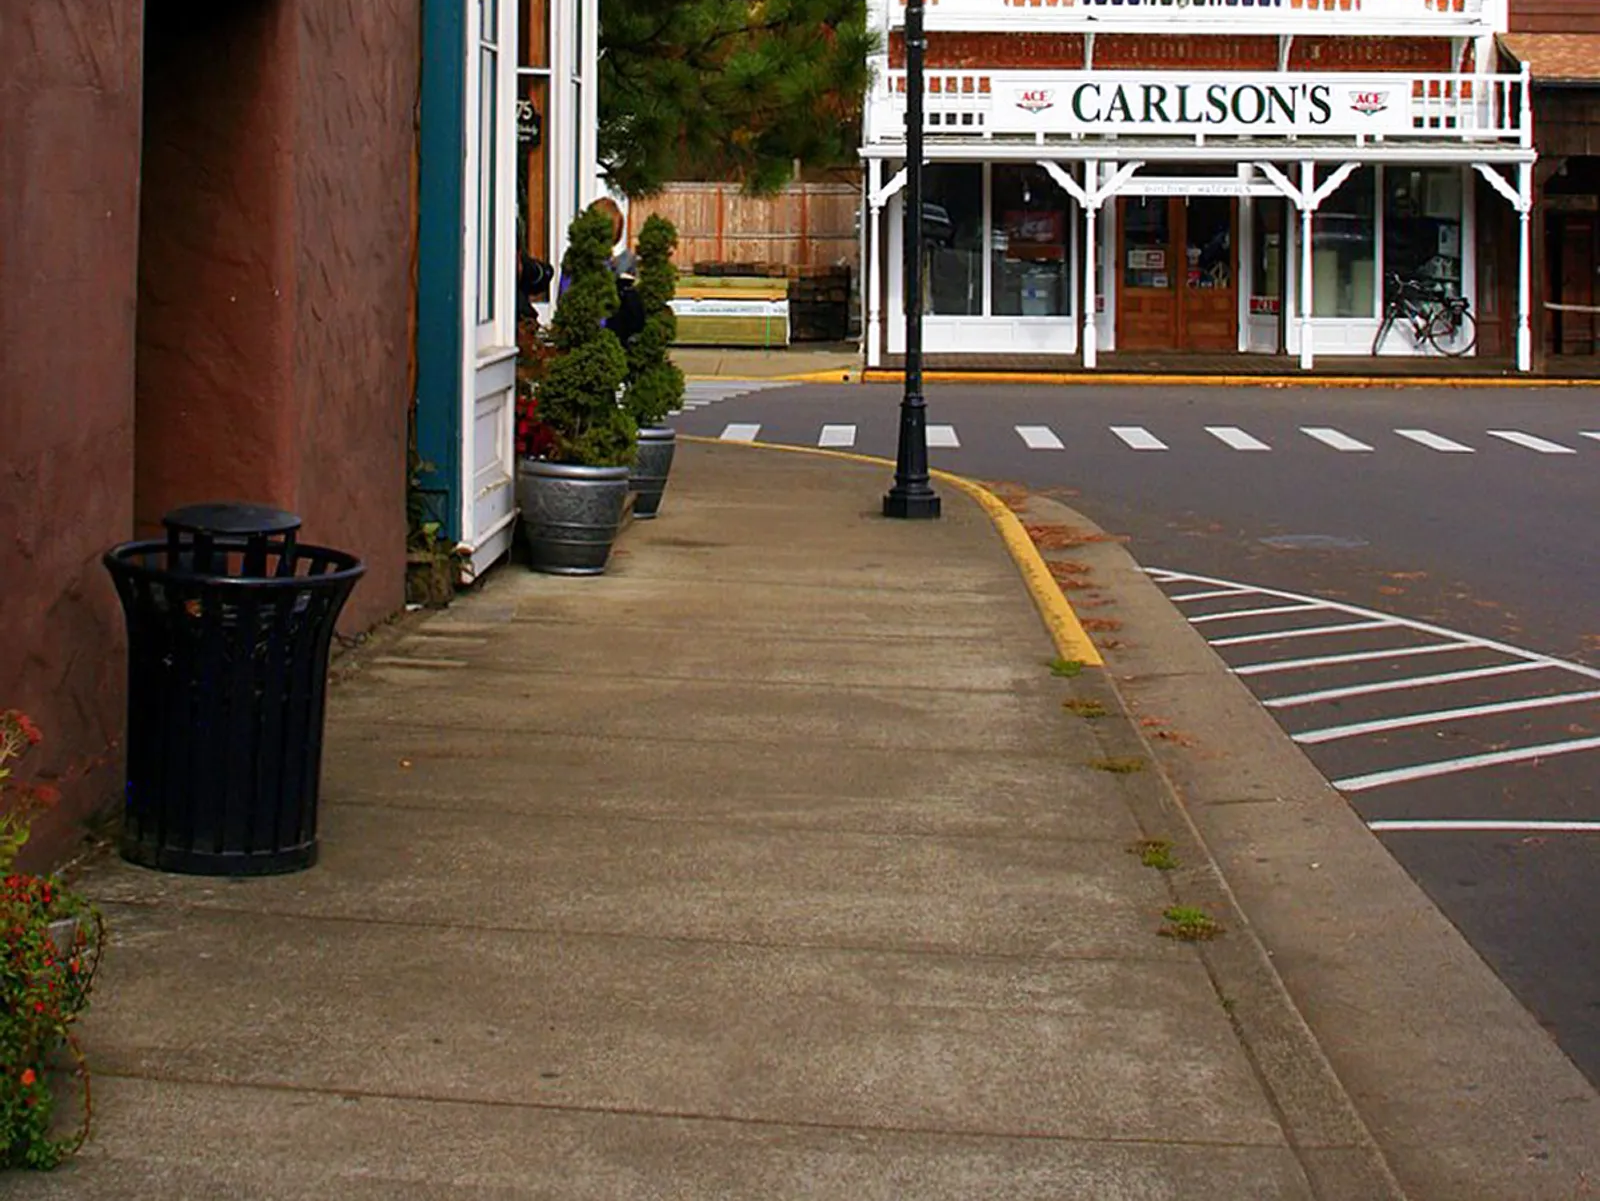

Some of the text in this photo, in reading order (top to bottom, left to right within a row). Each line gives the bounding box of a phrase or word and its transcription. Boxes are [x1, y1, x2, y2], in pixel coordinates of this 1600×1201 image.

[1021, 89, 1049, 102] ACE
[1355, 91, 1383, 105] ACE
[1071, 82, 1332, 125] CARLSON'S
